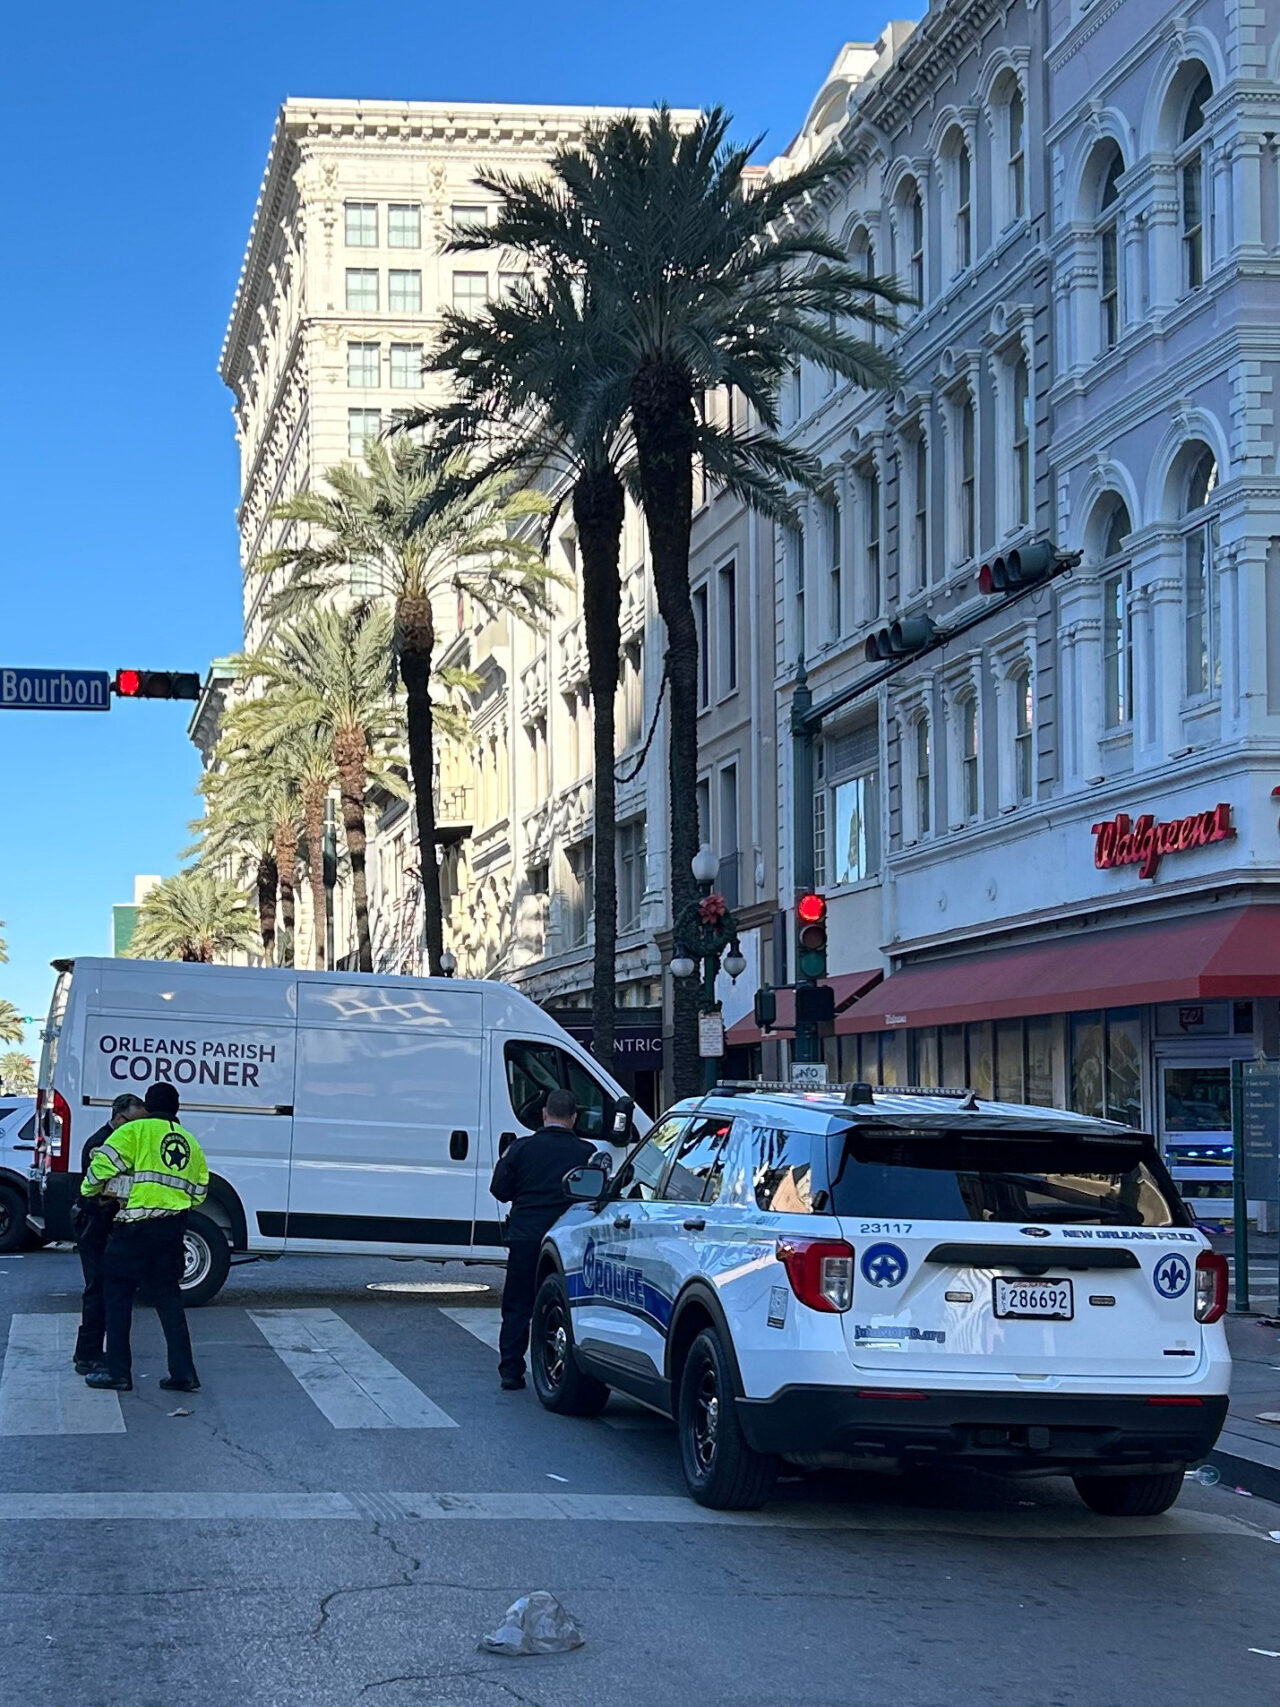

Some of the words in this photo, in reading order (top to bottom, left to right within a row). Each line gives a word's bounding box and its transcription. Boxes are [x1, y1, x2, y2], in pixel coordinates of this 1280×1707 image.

[2, 670, 102, 703] Bourbon
[1091, 803, 1237, 879] Walgreens
[99, 1035, 197, 1056] ORLEANS
[202, 1041, 276, 1063] PARISH
[589, 1038, 662, 1052] CNTRIC
[110, 1055, 260, 1088] CORONER
[860, 1223, 913, 1234] 23117
[1062, 1229, 1093, 1239] NEW
[1095, 1230, 1157, 1241] ORLEANS
[594, 1257, 646, 1309] POLICE
[1009, 1289, 1068, 1309] 286692
